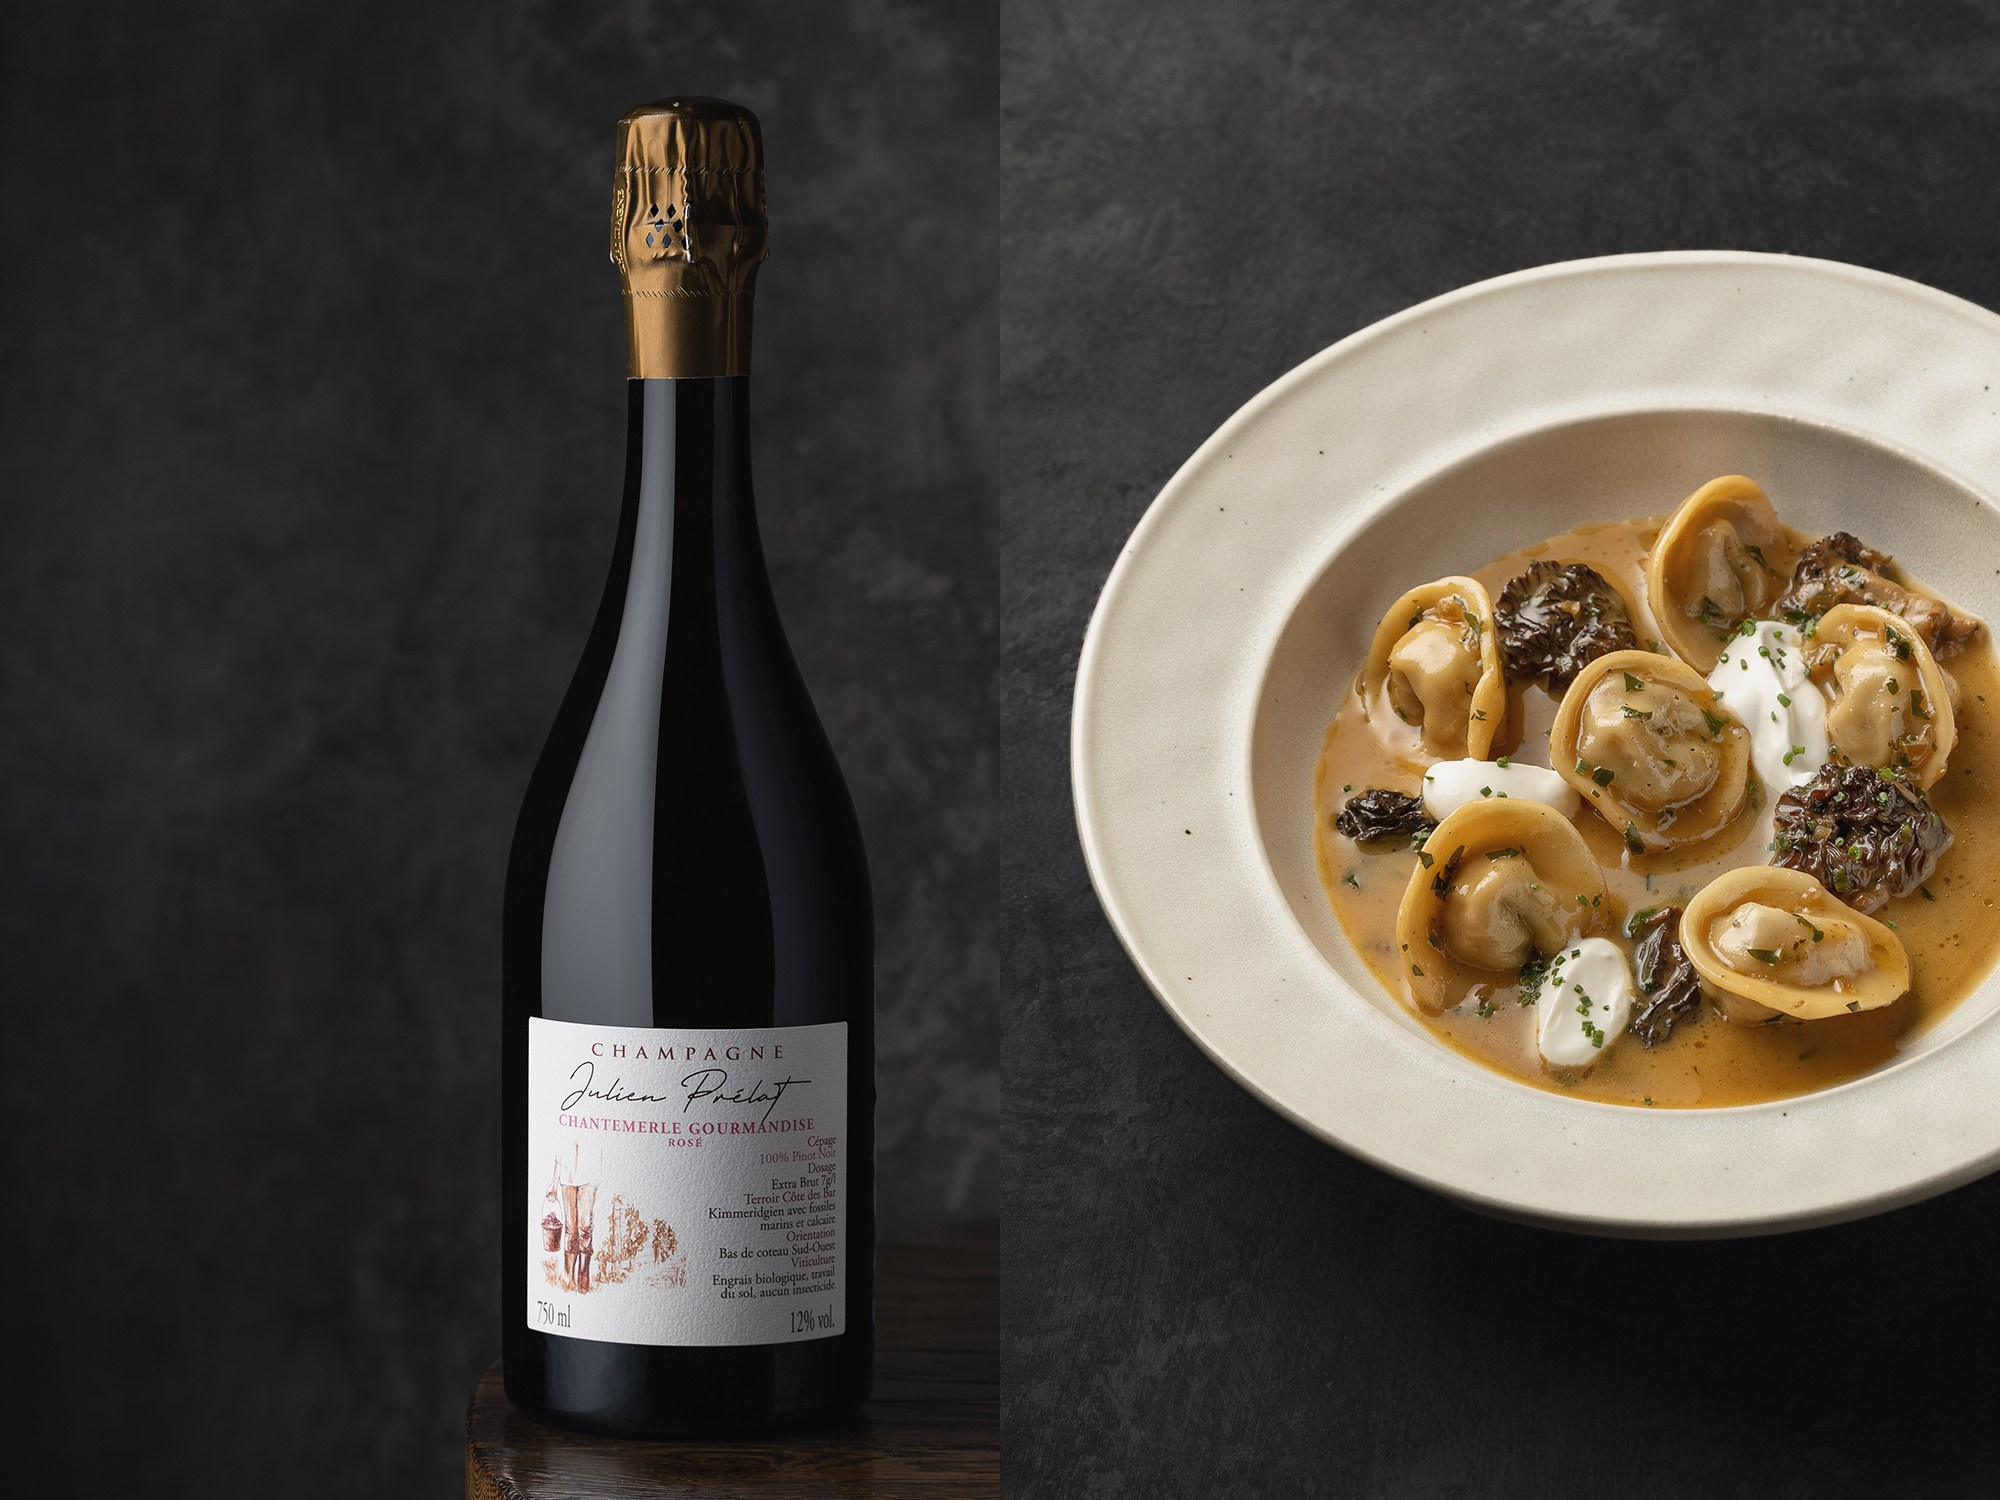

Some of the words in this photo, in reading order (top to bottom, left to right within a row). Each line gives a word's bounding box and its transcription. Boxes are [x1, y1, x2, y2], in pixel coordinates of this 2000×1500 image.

[591, 1042, 783, 1060] CHAMPAGNE
[560, 1061, 667, 1112] Julien
[680, 1068, 812, 1122] Prélat
[559, 1113, 682, 1135] CHANTEMERLE
[688, 1117, 815, 1135] GOURMANDISE
[668, 1136, 703, 1148] ROSÉ
[808, 1136, 836, 1149] Cépage
[760, 1153, 789, 1164] 100%
[792, 1150, 816, 1161] Pinot
[818, 1148, 836, 1159] Noir
[808, 1162, 836, 1174] Dosage
[772, 1180, 797, 1190] Extra
[800, 1177, 819, 1187] Brut
[822, 1173, 836, 1188] 7g/l
[744, 1194, 780, 1205] Terroir
[782, 1191, 805, 1202] Côte
[808, 1190, 821, 1200] des
[823, 1188, 836, 1198] Bar
[708, 1207, 784, 1220] Kimmeridgien
[788, 1206, 807, 1215] avec
[809, 1201, 836, 1213] fossiles
[760, 1219, 794, 1230] marins
[807, 1214, 836, 1226] calcaire
[786, 1228, 836, 1242] Orientation
[720, 1248, 738, 1258] Bas
[741, 1247, 754, 1258] de
[757, 1247, 789, 1256] coteau
[792, 1242, 836, 1255] Sud-Ouest
[792, 1255, 836, 1268] Viticulture
[712, 1274, 752, 1288] Engrais
[756, 1272, 809, 1286] biologique,
[812, 1265, 835, 1279] travail
[721, 1288, 735, 1299] du
[738, 1287, 756, 1299] sol,
[760, 1288, 790, 1297] aucun
[793, 1279, 836, 1294] insecticide
[536, 1300, 555, 1325] 750
[557, 1304, 571, 1328] ml
[790, 1308, 815, 1334] 12%
[818, 1304, 835, 1328] vol.
